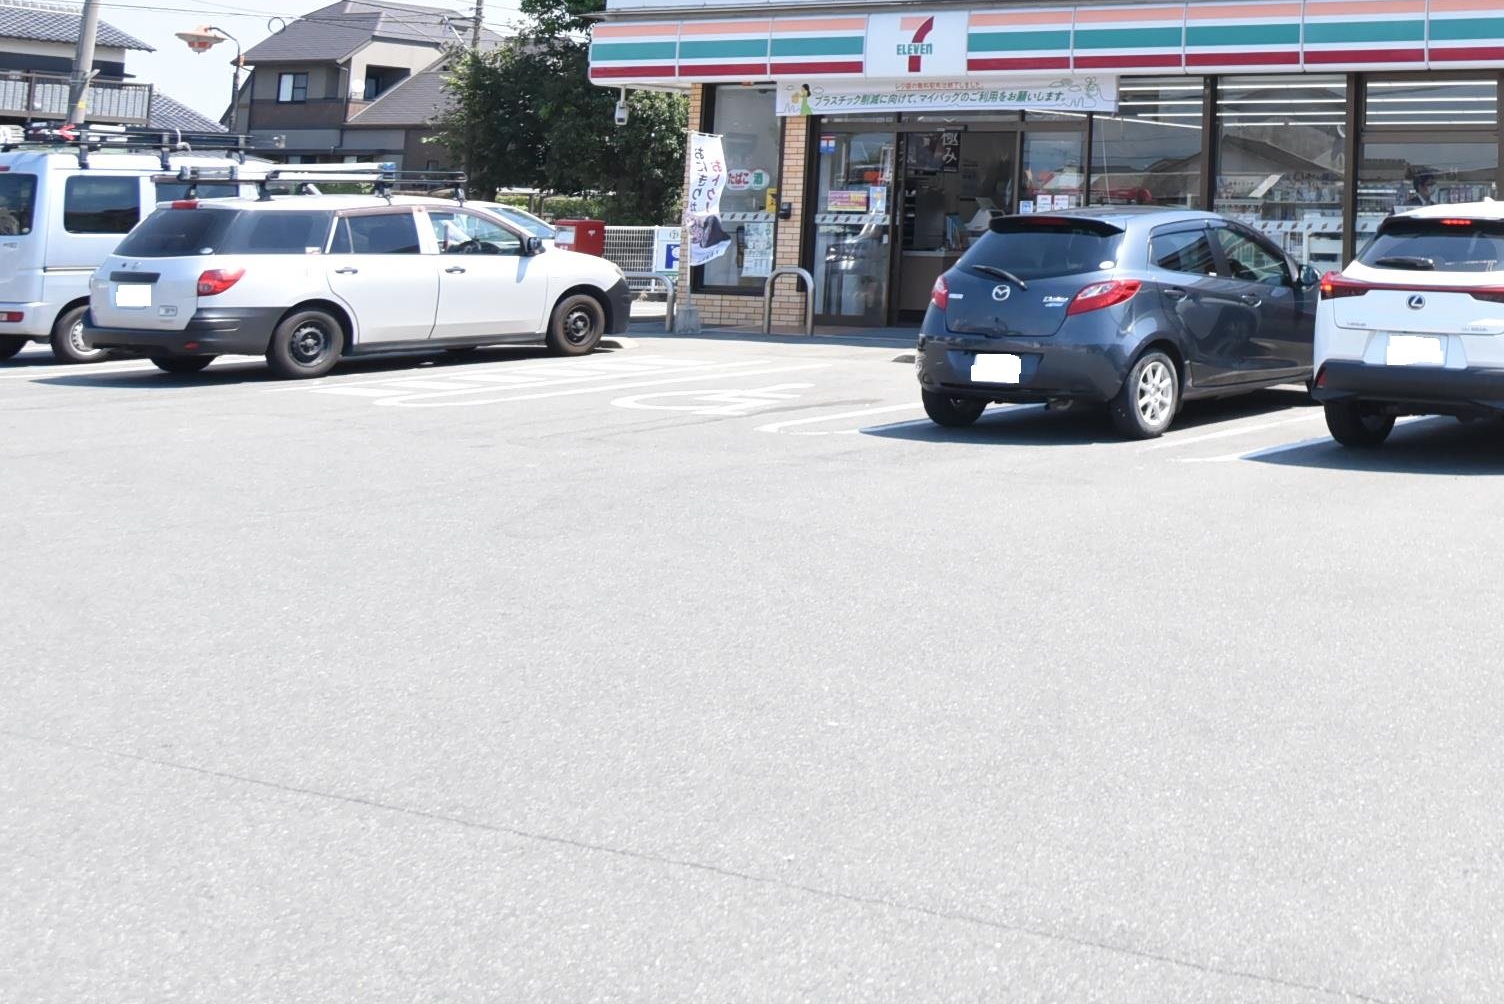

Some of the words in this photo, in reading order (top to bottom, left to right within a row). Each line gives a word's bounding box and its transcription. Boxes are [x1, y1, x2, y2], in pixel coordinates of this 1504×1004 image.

[815, 90, 1066, 106] プラスチック削減に向けて、マイバッグのご利用をお願いします。
[728, 171, 750, 185] たばこ
